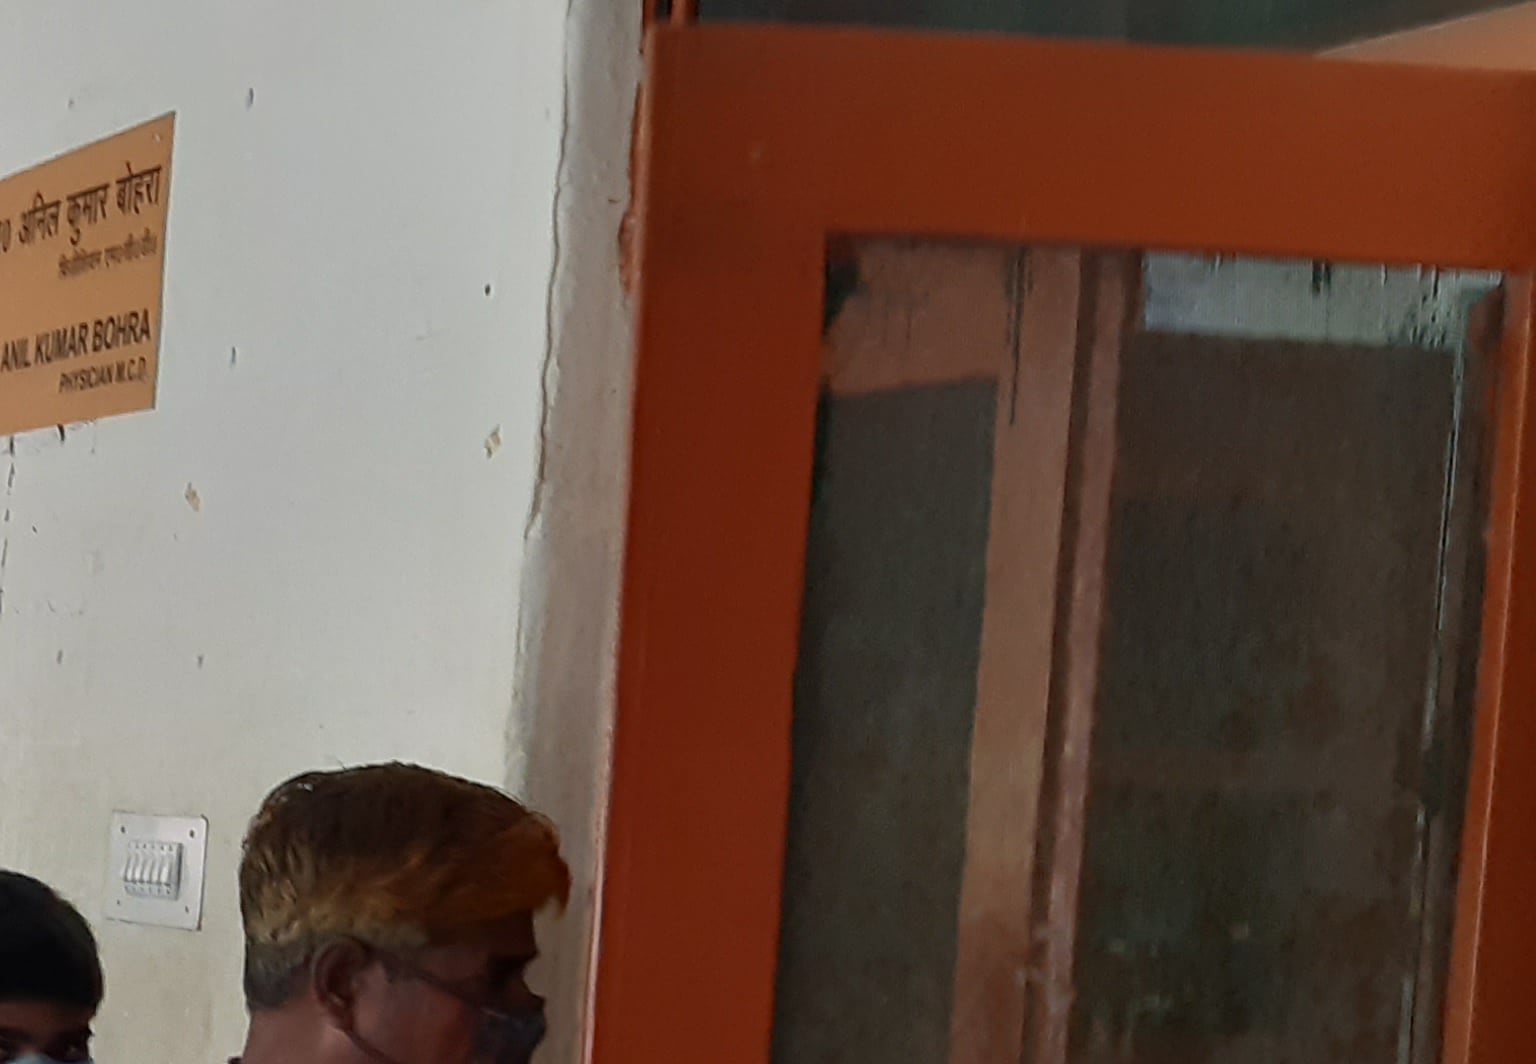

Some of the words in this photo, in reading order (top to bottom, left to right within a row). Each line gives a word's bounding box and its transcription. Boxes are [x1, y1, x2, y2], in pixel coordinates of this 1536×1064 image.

[18, 189, 61, 245] अनिल
[66, 183, 109, 246] कुमार
[115, 162, 161, 214] बोहरा
[0, 337, 31, 373] ANIL
[34, 321, 88, 366] KUMAR
[91, 308, 151, 349] BOHRA
